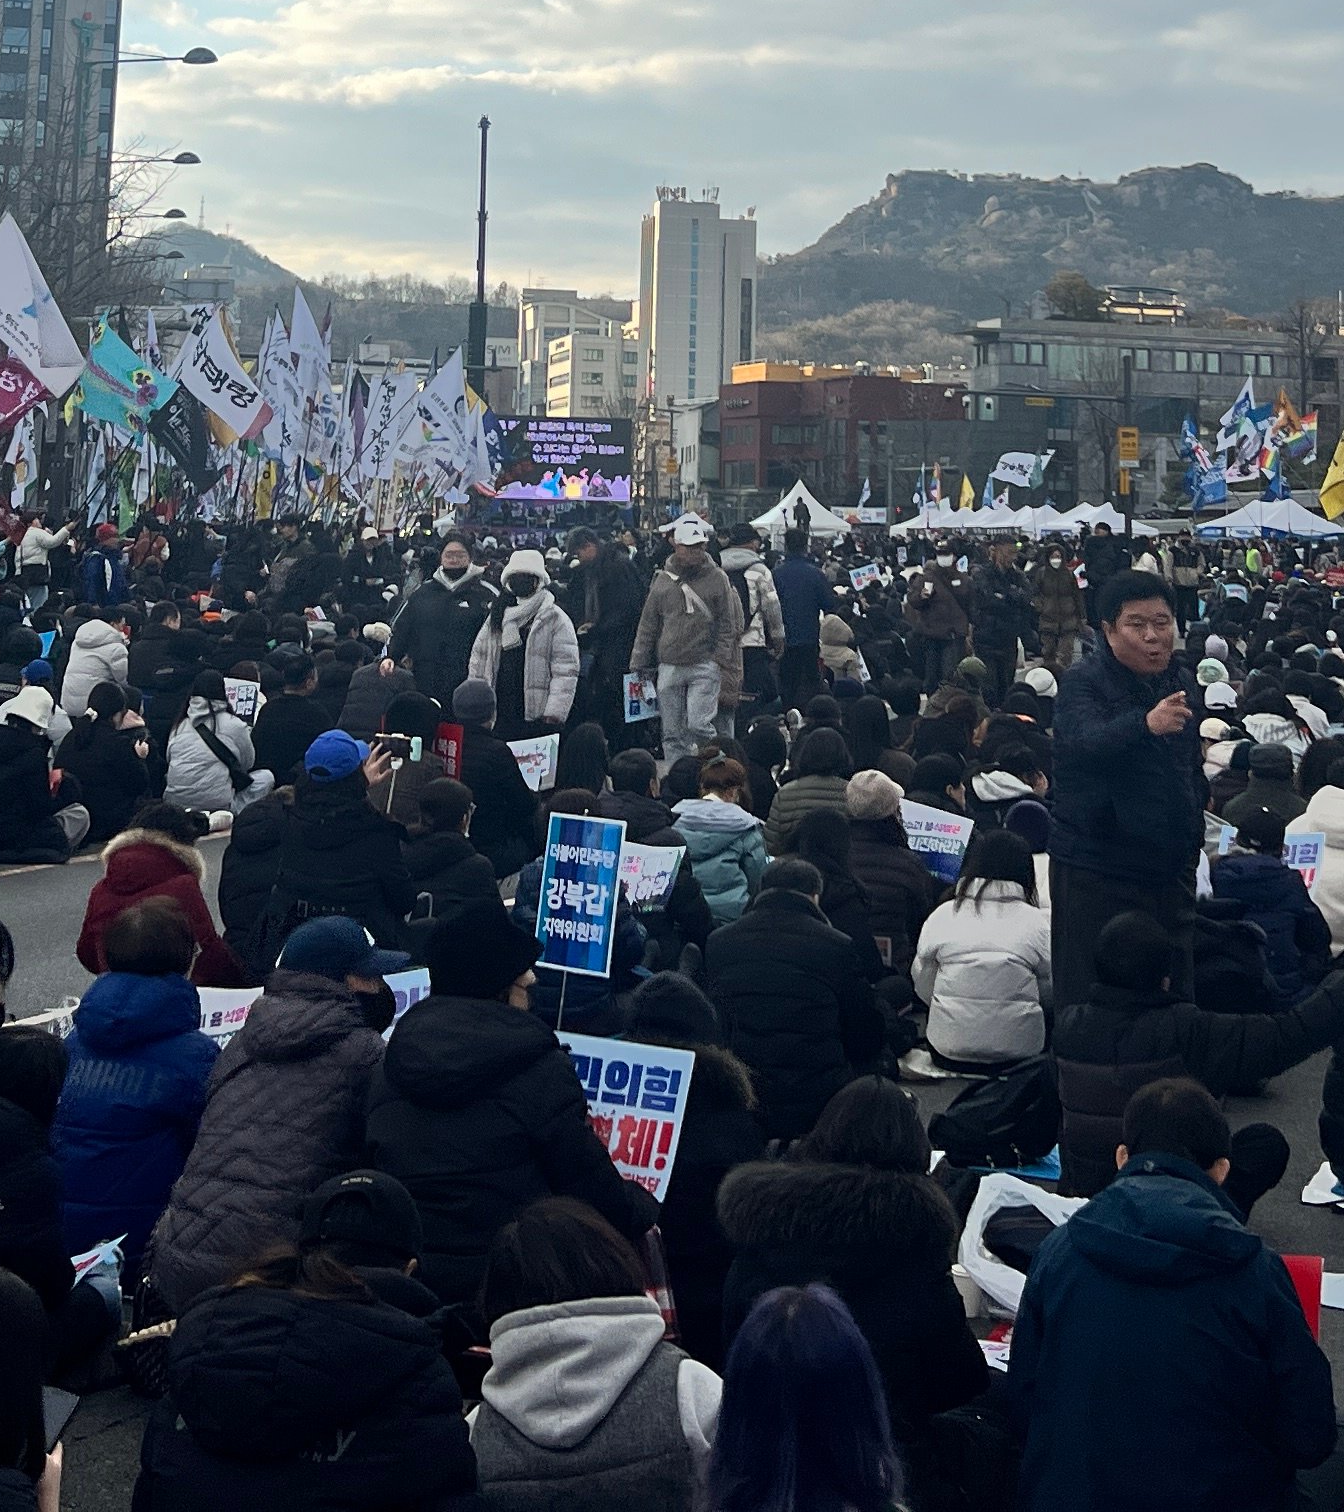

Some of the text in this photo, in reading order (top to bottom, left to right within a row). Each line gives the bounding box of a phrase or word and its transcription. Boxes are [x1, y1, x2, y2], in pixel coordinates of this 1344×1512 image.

[549, 843, 616, 868] 더불어민주당
[546, 877, 609, 917] 강북갑
[543, 917, 604, 945] 지역위원회
